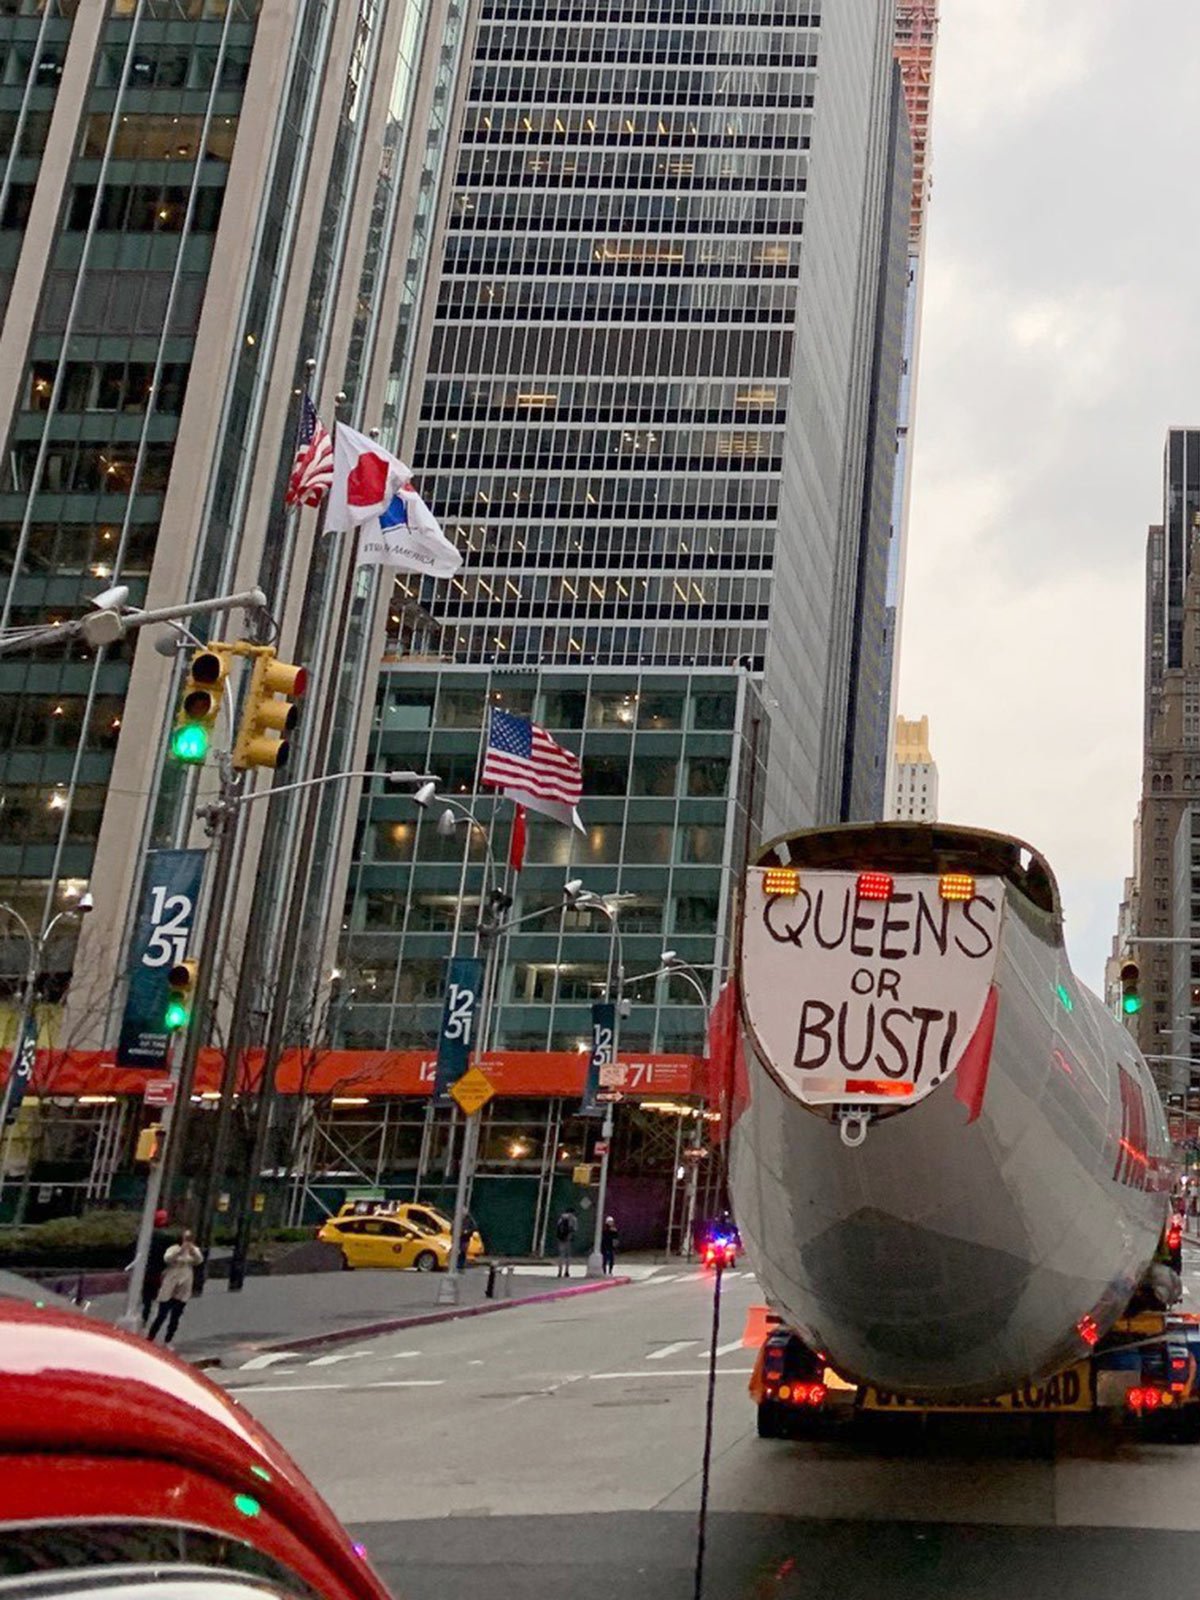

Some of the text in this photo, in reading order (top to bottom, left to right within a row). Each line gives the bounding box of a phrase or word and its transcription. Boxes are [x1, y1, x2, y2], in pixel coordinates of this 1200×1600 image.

[763, 887, 994, 960] QUEENS
[851, 968, 901, 1001] OR
[794, 1000, 957, 1087] BUST!
